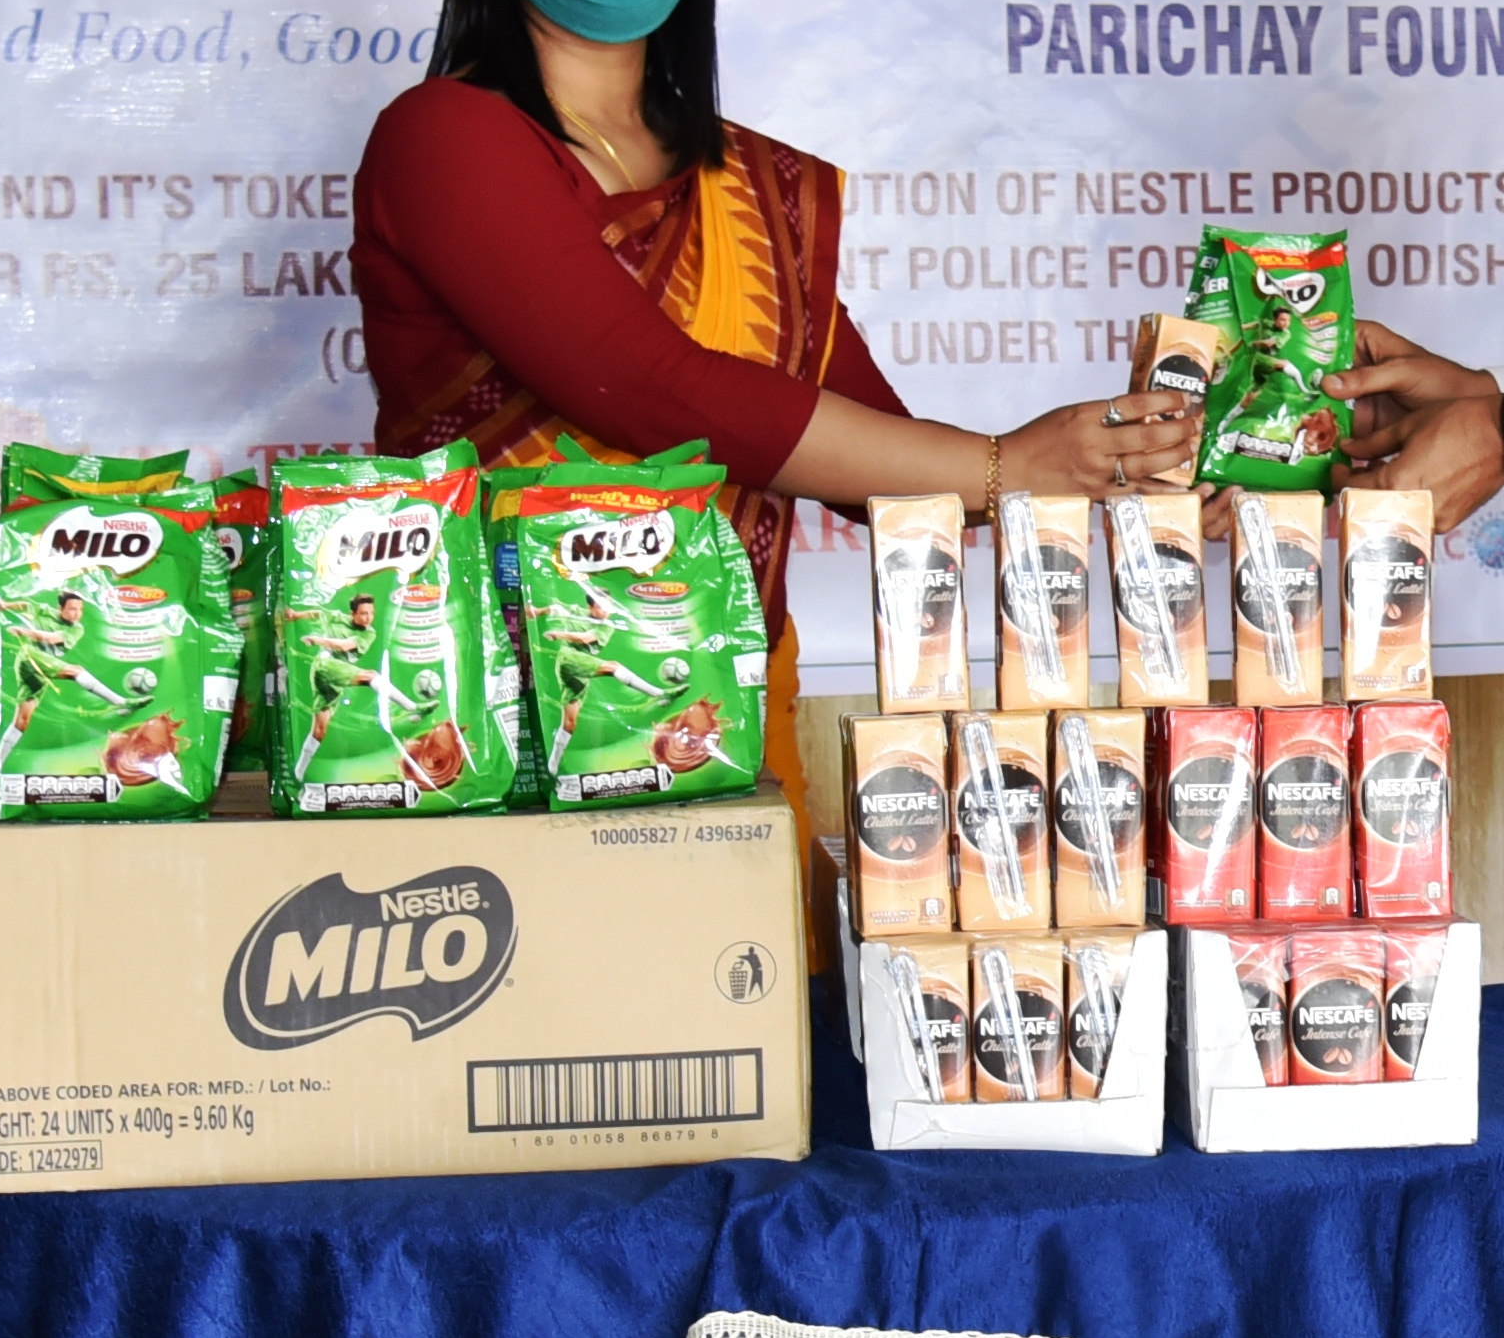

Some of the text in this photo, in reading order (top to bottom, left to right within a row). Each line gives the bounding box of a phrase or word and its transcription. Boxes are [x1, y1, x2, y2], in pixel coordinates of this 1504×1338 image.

[71, 9, 252, 69] Food,
[1006, 2, 1323, 77] PARICHAY
[97, 173, 195, 220] IT'S
[213, 173, 355, 219] TOKE
[996, 171, 1057, 216] OF
[1075, 171, 1254, 215] NESTLE
[156, 251, 220, 298] 25
[243, 250, 359, 297] LAK
[908, 245, 1089, 291] POLICE
[891, 318, 1135, 366] UNDER TH
[50, 528, 151, 558] MILO
[337, 526, 431, 565] MILO
[571, 526, 661, 562] MILO
[590, 827, 678, 845] 100005827
[694, 824, 773, 843] 43963347
[264, 914, 488, 1007] MILO
[1391, 1002, 1430, 1021] NES
[1393, 1023, 1424, 1036] Inten
[56, 1084, 113, 1100] CODED
[118, 1083, 162, 1098] AREA
[167, 1081, 203, 1097] FOR:
[270, 1078, 295, 1093] Lot
[41, 1110, 60, 1136] 24
[65, 1108, 115, 1135] UNITS
[134, 1106, 174, 1139] 400g
[193, 1105, 227, 1131] 9.60
[232, 1103, 255, 1136] Kg
[570, 1131, 625, 1145] 01058
[641, 1129, 696, 1143] 86879
[28, 1146, 98, 1172] 12422979
